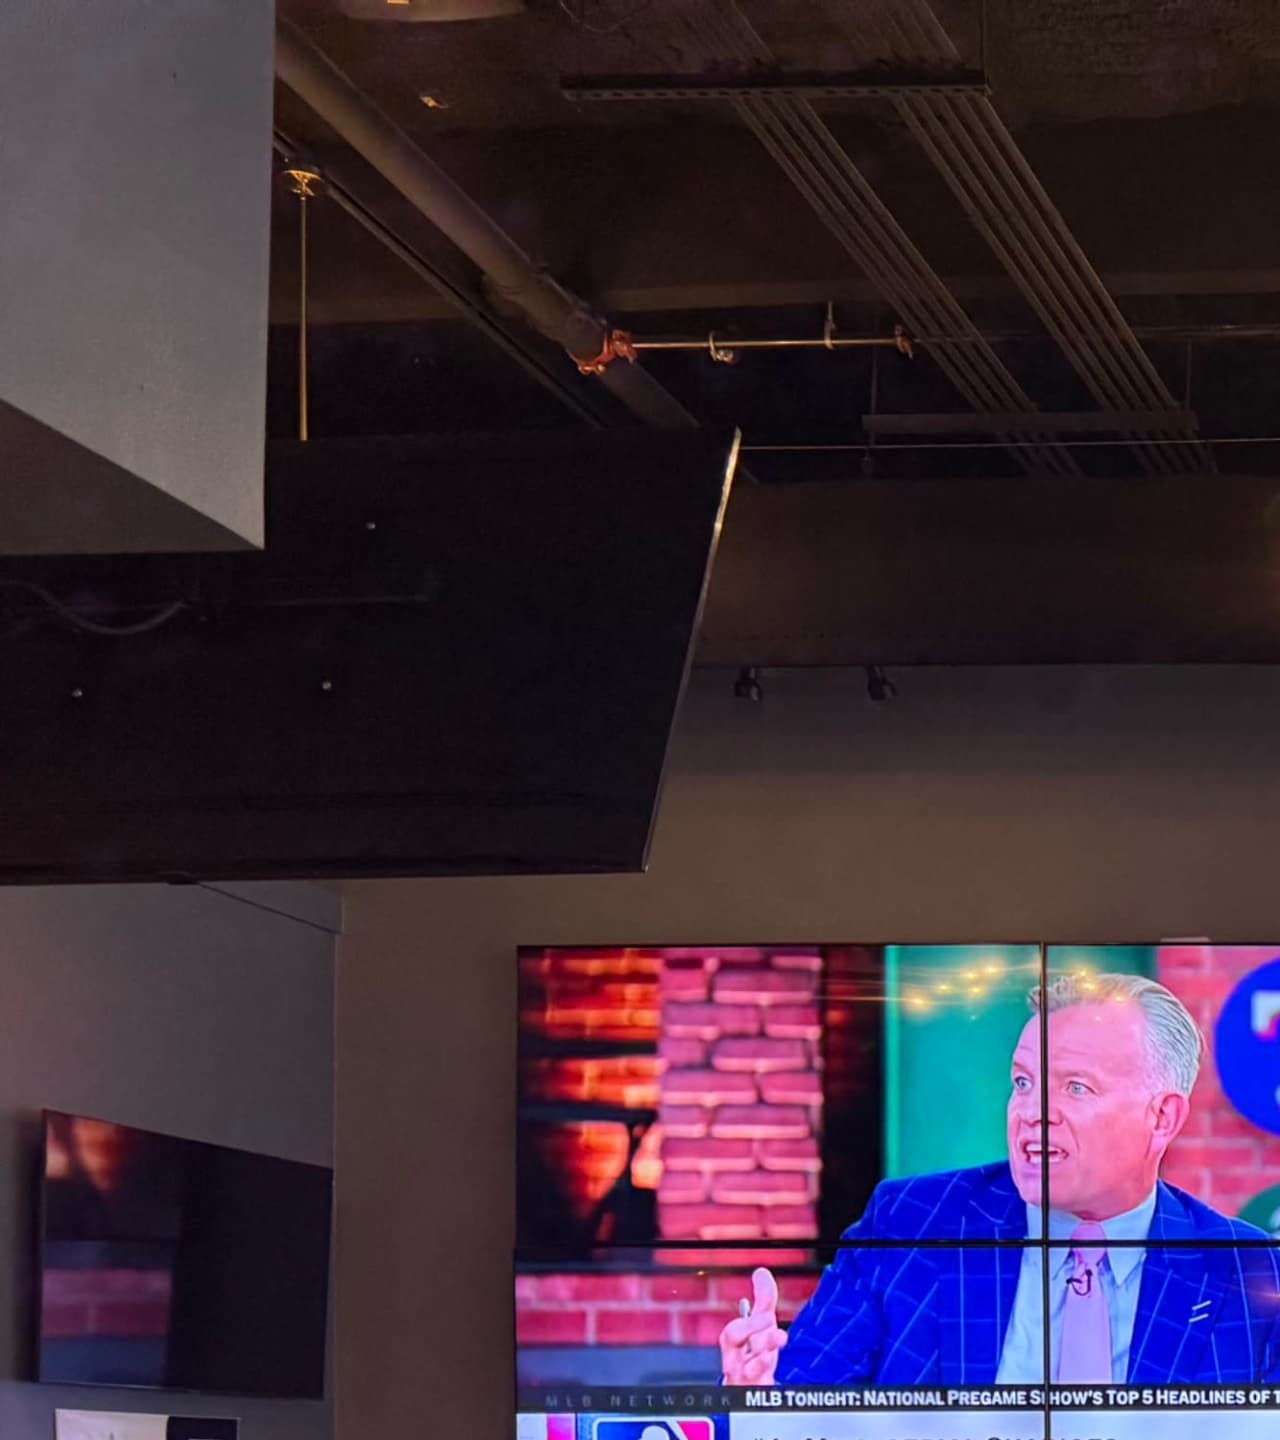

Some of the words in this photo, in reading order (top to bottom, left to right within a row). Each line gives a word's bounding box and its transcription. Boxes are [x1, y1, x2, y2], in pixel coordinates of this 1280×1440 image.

[745, 1391, 782, 1406] MLB
[784, 1391, 861, 1406] TONIGHT:
[864, 1390, 945, 1406] NATIONAL
[947, 1390, 1027, 1405] PREGAME
[1106, 1390, 1140, 1404] TOP
[1142, 1390, 1153, 1404] 5
[1156, 1389, 1246, 1404] HEADLINES
[1249, 1389, 1270, 1404] OF
